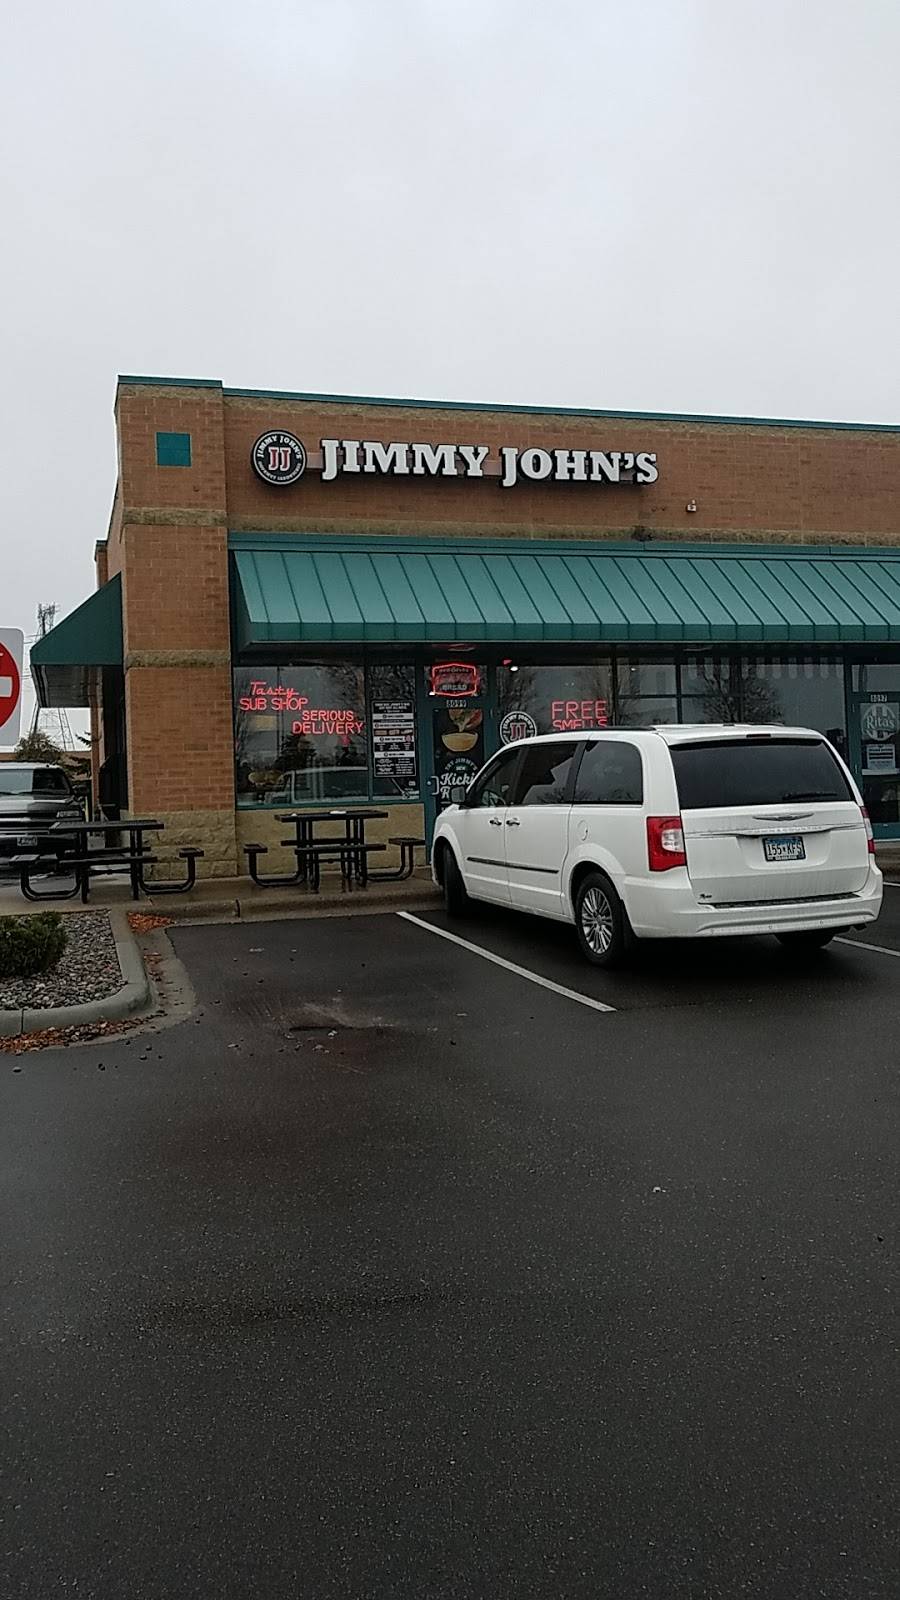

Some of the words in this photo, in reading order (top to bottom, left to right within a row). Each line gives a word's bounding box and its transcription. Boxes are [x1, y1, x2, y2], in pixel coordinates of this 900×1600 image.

[256, 435, 277, 458] JIMMY
[279, 435, 302, 460] JOHN'S
[267, 446, 291, 471] JJ
[321, 439, 489, 480] JIMMY
[500, 446, 659, 487] JOHN'S
[250, 681, 299, 698] Tasty
[239, 698, 267, 711] SUB
[271, 697, 308, 711] SHOP
[551, 700, 607, 719] FREE
[302, 710, 354, 721] SERIOUS
[292, 721, 364, 734] DELIVERY
[440, 772, 475, 786] Kicki
[767, 843, 782, 856] 155
